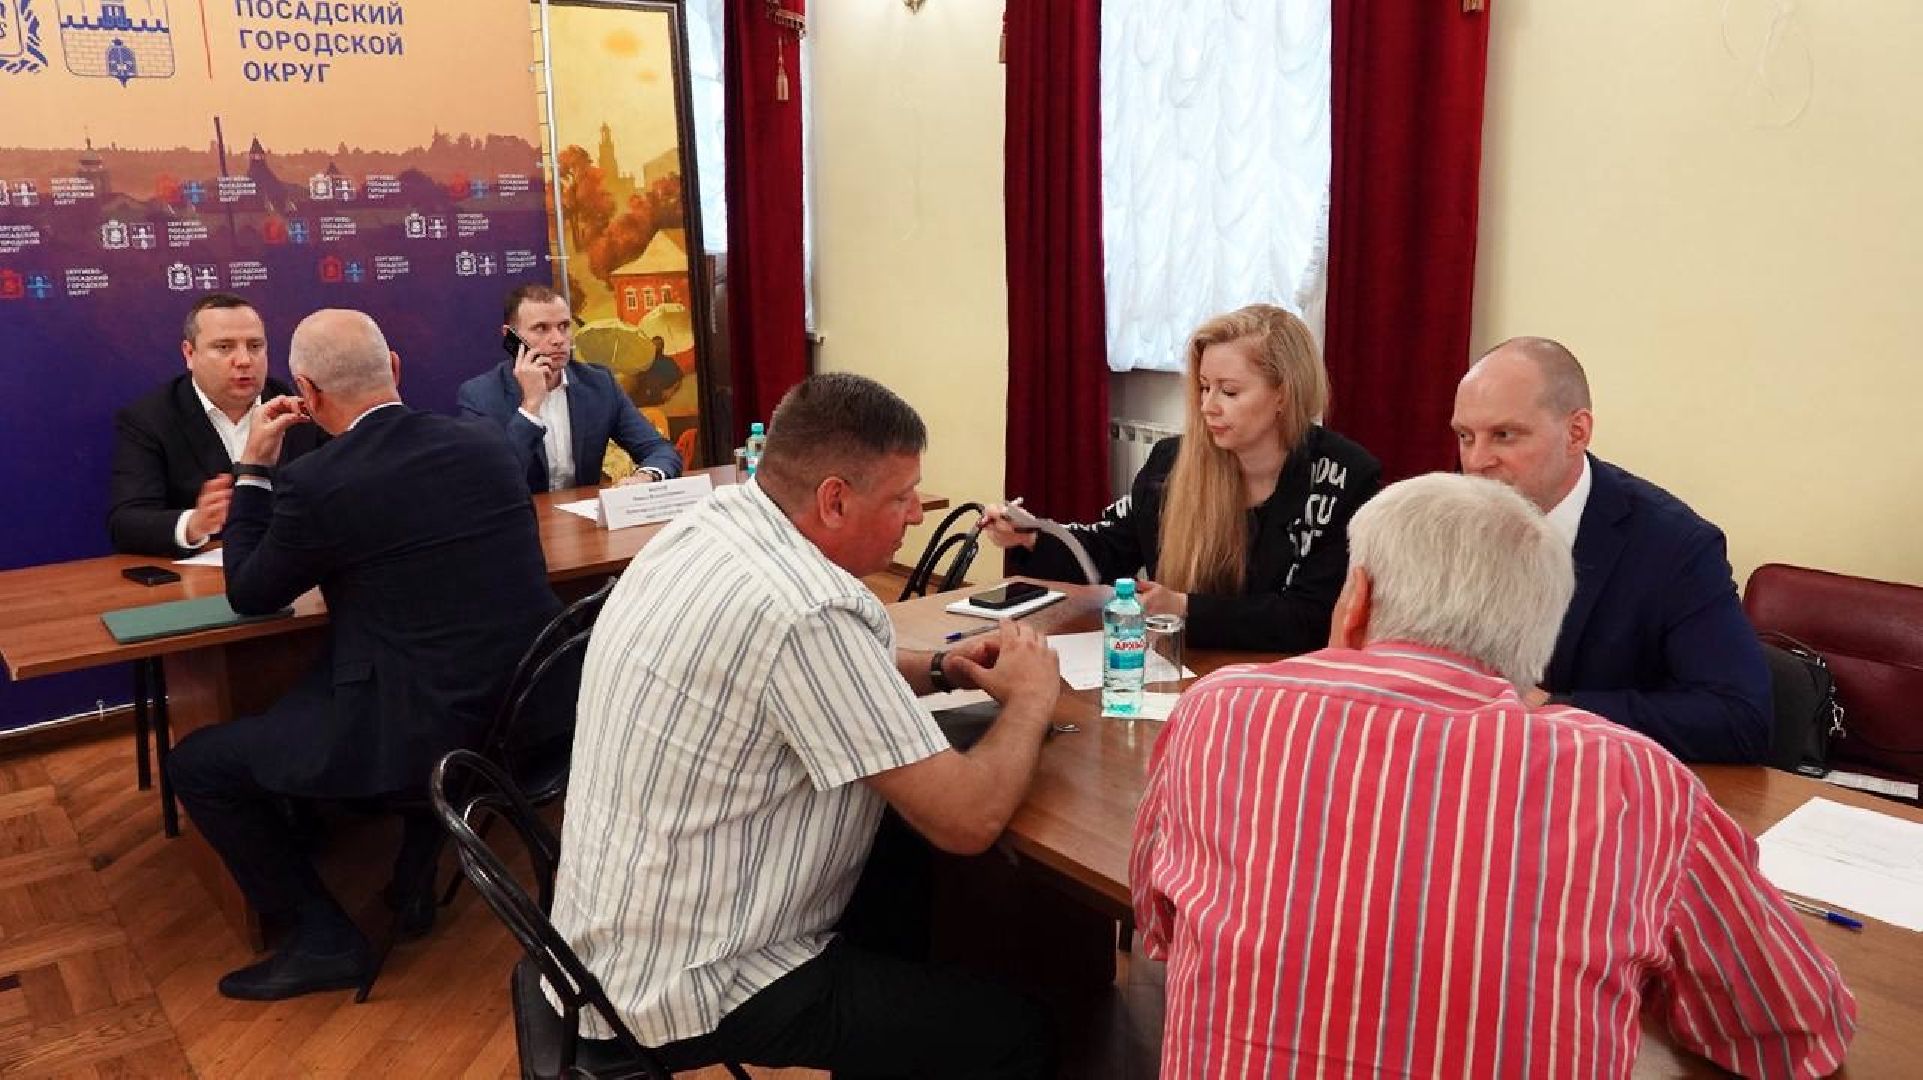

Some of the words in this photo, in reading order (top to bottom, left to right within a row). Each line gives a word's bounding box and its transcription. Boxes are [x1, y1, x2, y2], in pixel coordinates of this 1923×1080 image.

[236, 0, 404, 26] ПОСАДСКИЙ
[239, 30, 404, 57] ГОРОДСКОЙ
[243, 60, 331, 83] ОКРУГ
